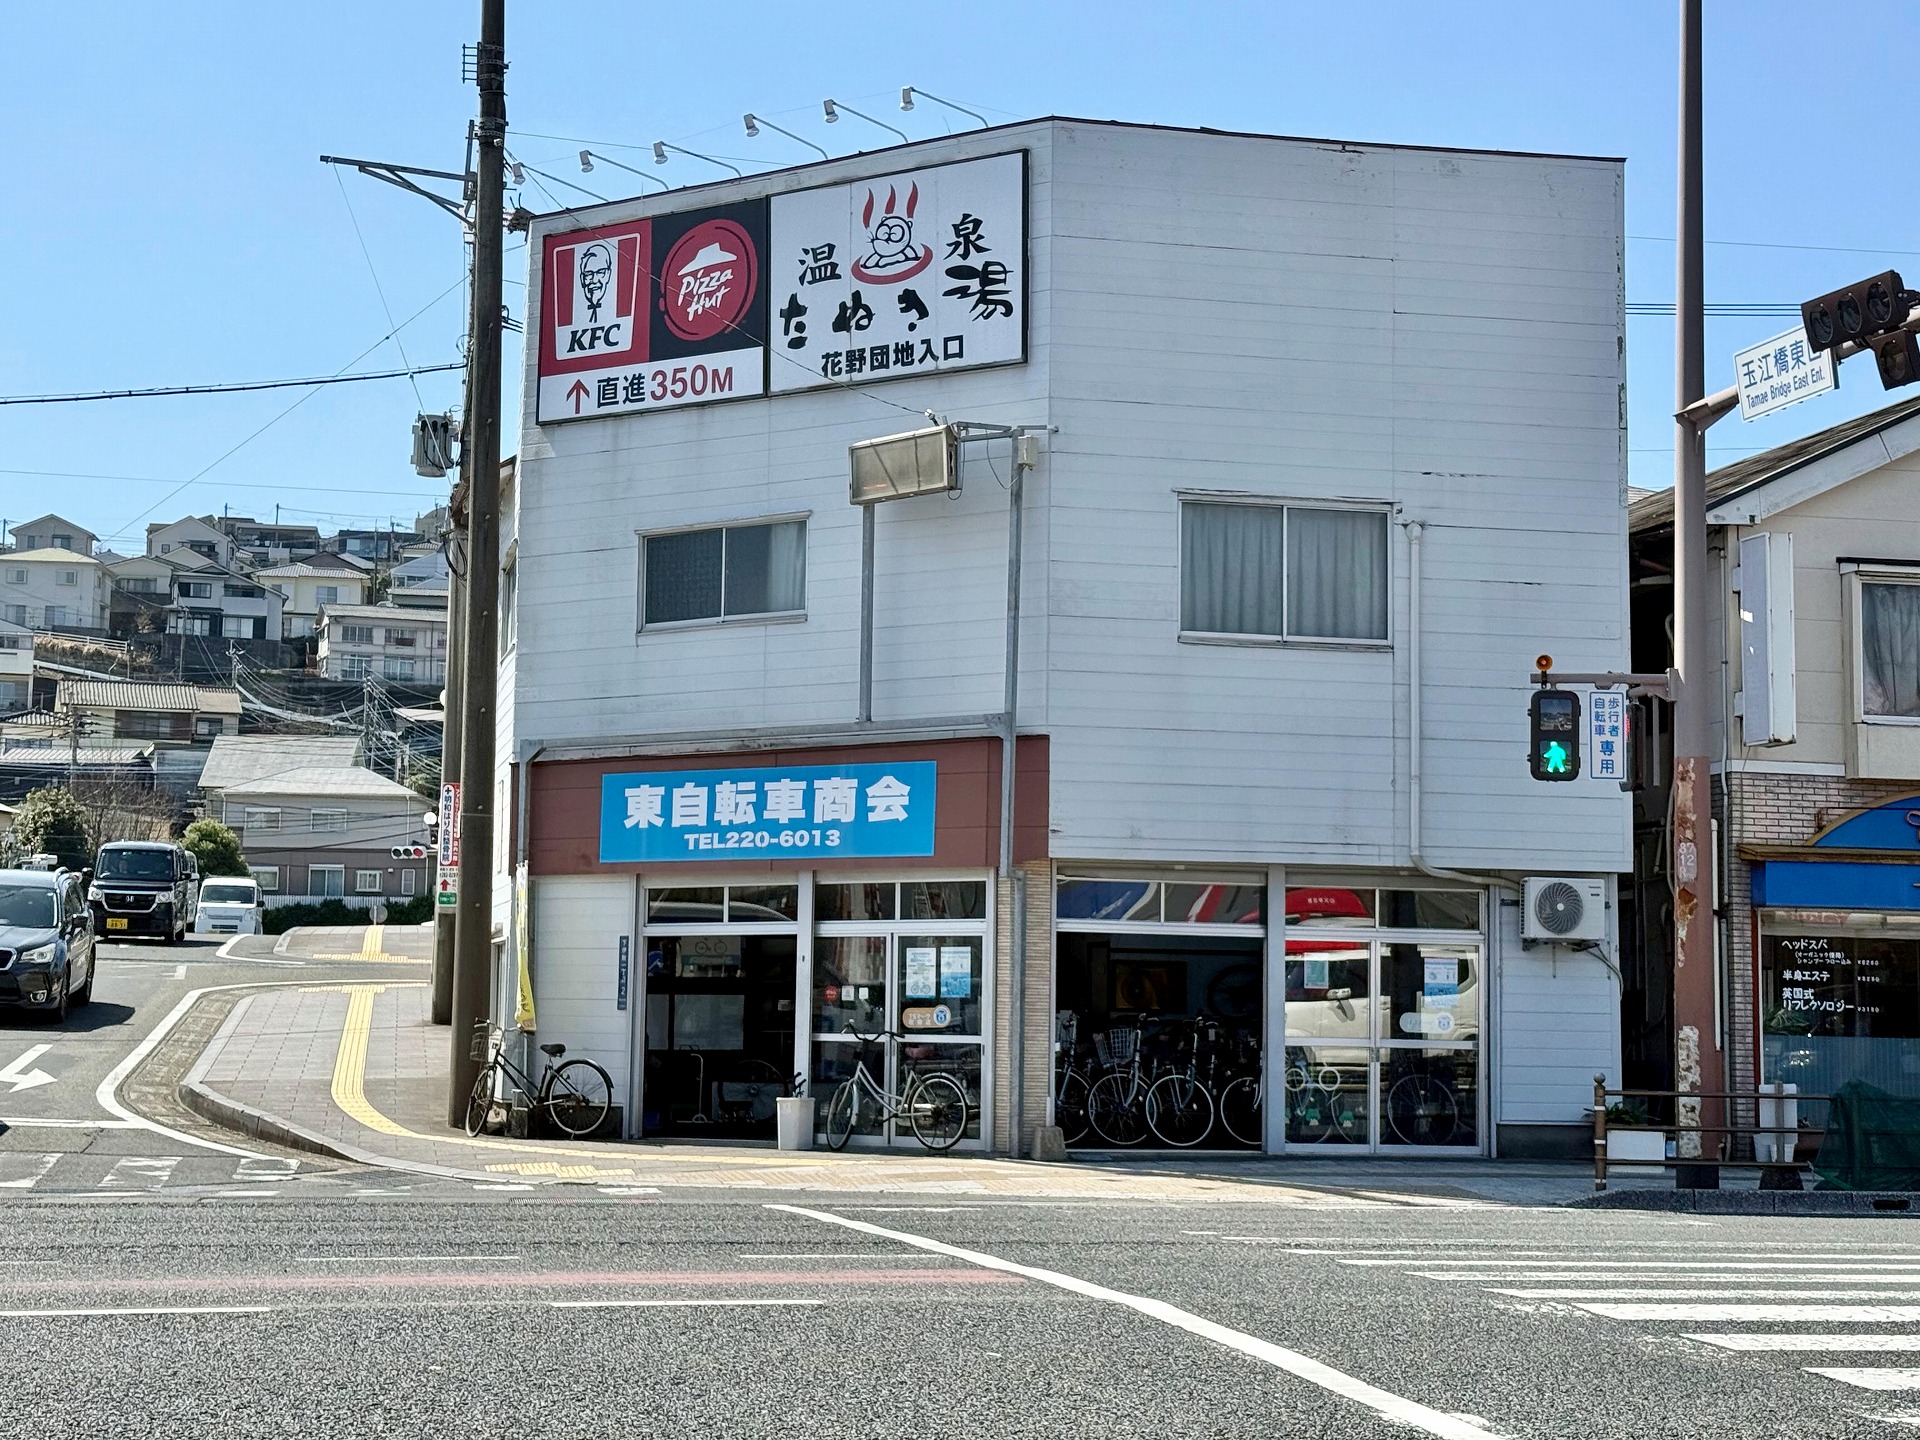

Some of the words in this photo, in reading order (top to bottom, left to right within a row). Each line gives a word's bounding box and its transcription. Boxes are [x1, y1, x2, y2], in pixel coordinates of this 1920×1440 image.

[798, 242, 842, 287] 温
[944, 213, 992, 261] 泉
[679, 268, 734, 307] Pizza
[688, 285, 730, 322] Hut
[779, 261, 1014, 350] たぬき湯
[567, 322, 622, 353] KFC
[821, 334, 965, 378] 花野団地入口
[1746, 391, 1769, 409] Tamae
[1770, 381, 1792, 400] Bridge
[1793, 371, 1809, 390] East
[1810, 365, 1826, 384] Ent.
[1594, 697, 1606, 737] 自転車
[1607, 697, 1620, 737] 歩行者
[1599, 740, 1615, 775] 専用
[624, 775, 912, 829] 東自転車商会
[684, 829, 841, 851] TEL220-6013
[1781, 938, 1828, 950] ヘッドスパ
[1782, 968, 1831, 982] 半身エステ
[1782, 986, 1815, 1000] 英国式
[1783, 999, 1855, 1013] リフレクソロジー
